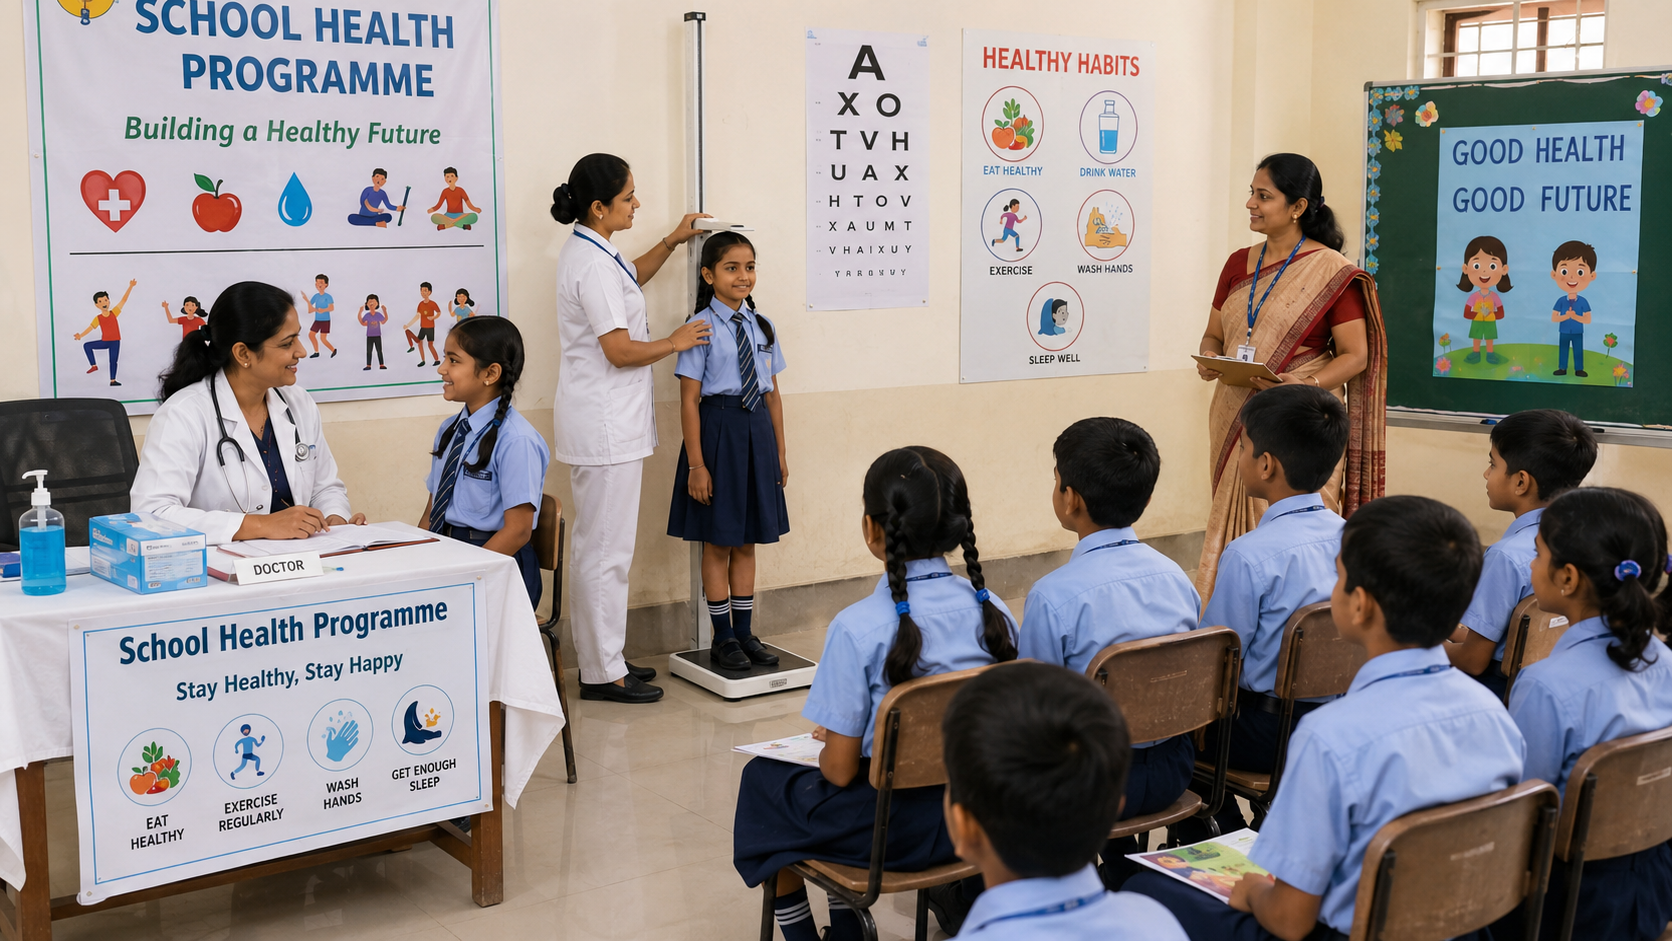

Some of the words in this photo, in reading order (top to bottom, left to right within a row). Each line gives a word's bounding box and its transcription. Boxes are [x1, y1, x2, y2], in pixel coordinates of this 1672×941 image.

[136, 0, 301, 41] SCHOOL
[315, 8, 453, 48] HEALTH
[848, 45, 885, 80] A
[984, 47, 1072, 72] HEALTHY
[1078, 53, 1139, 76] HABITS
[183, 54, 434, 97] PROGRAMME
[125, 116, 234, 147] Building
[243, 125, 257, 141] a
[267, 120, 360, 149] Healthy
[368, 122, 440, 144] Future
[1453, 139, 1523, 165] GOOD
[1536, 135, 1624, 163] HEALTH
[983, 165, 1001, 176] EAT
[1003, 166, 1043, 177] HEALTHY
[1080, 167, 1106, 177] DRINK
[1108, 168, 1137, 178] WATER
[1453, 187, 1524, 212] GOOD
[1542, 185, 1631, 211] FUTURE
[989, 266, 1033, 275] EXERCISE
[1077, 264, 1102, 274] WASH
[1104, 264, 1133, 274] HANDS
[1029, 355, 1056, 365] SLEEP
[1057, 353, 1081, 363] WELL
[253, 560, 305, 576] DOCTOR
[120, 627, 208, 664] School
[220, 615, 304, 651] Health
[314, 602, 447, 639] Programme
[177, 682, 217, 701] Stay
[225, 668, 298, 693] Healthy,
[306, 663, 343, 681] Stay
[350, 654, 403, 674] Happy
[391, 766, 411, 781] GET
[414, 759, 457, 779] ENOUGH
[326, 778, 360, 794] WASH
[409, 776, 441, 793] SLEEP
[224, 794, 279, 814] EXERCISE
[323, 792, 363, 810] HANDS
[147, 815, 168, 829] EAT
[218, 808, 285, 832] REGULARLY
[130, 828, 185, 850] HEALTHY
